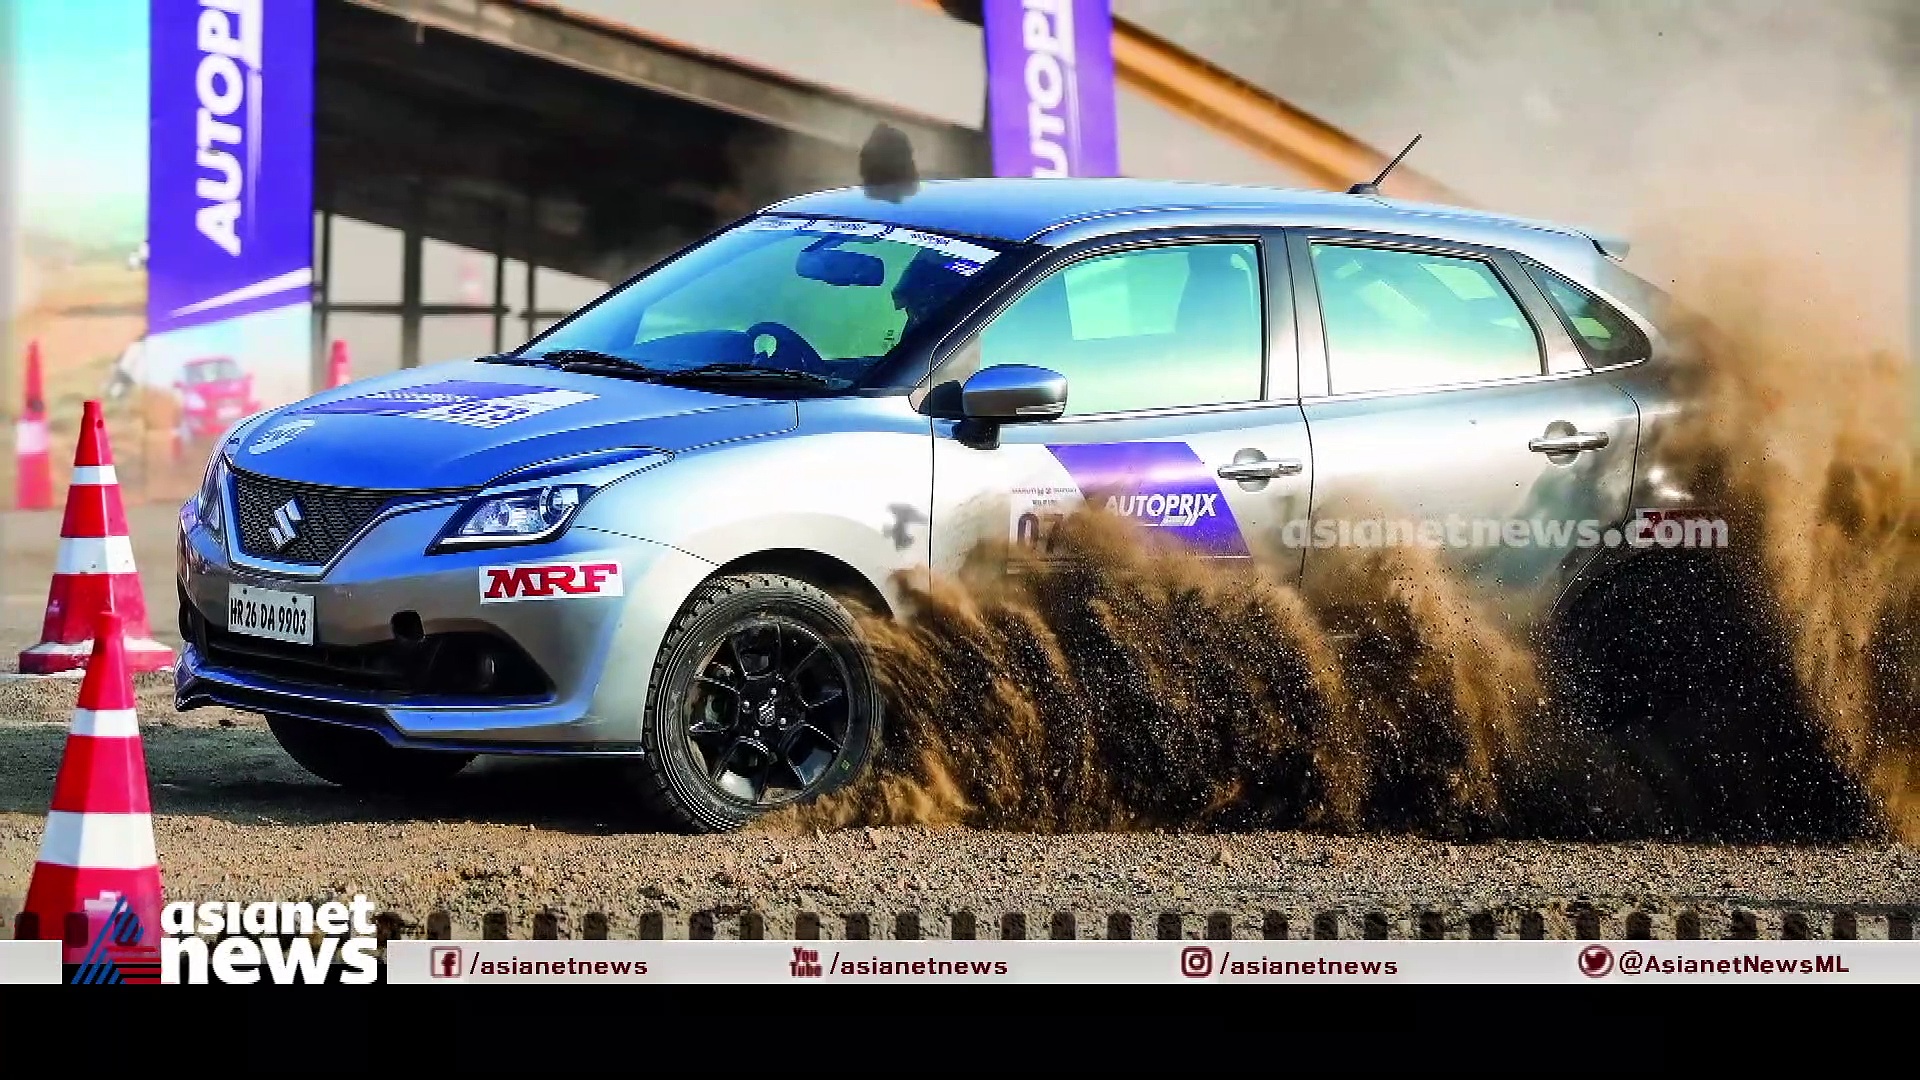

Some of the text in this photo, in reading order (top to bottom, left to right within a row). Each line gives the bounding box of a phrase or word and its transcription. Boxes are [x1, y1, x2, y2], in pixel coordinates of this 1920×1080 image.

[1022, 0, 1068, 177] UTOP
[196, 0, 245, 256] AUTOP
[1104, 494, 1217, 517] AUTOPRIX
[484, 564, 617, 598] MRF
[230, 597, 306, 635] HR 26 DA 9903
